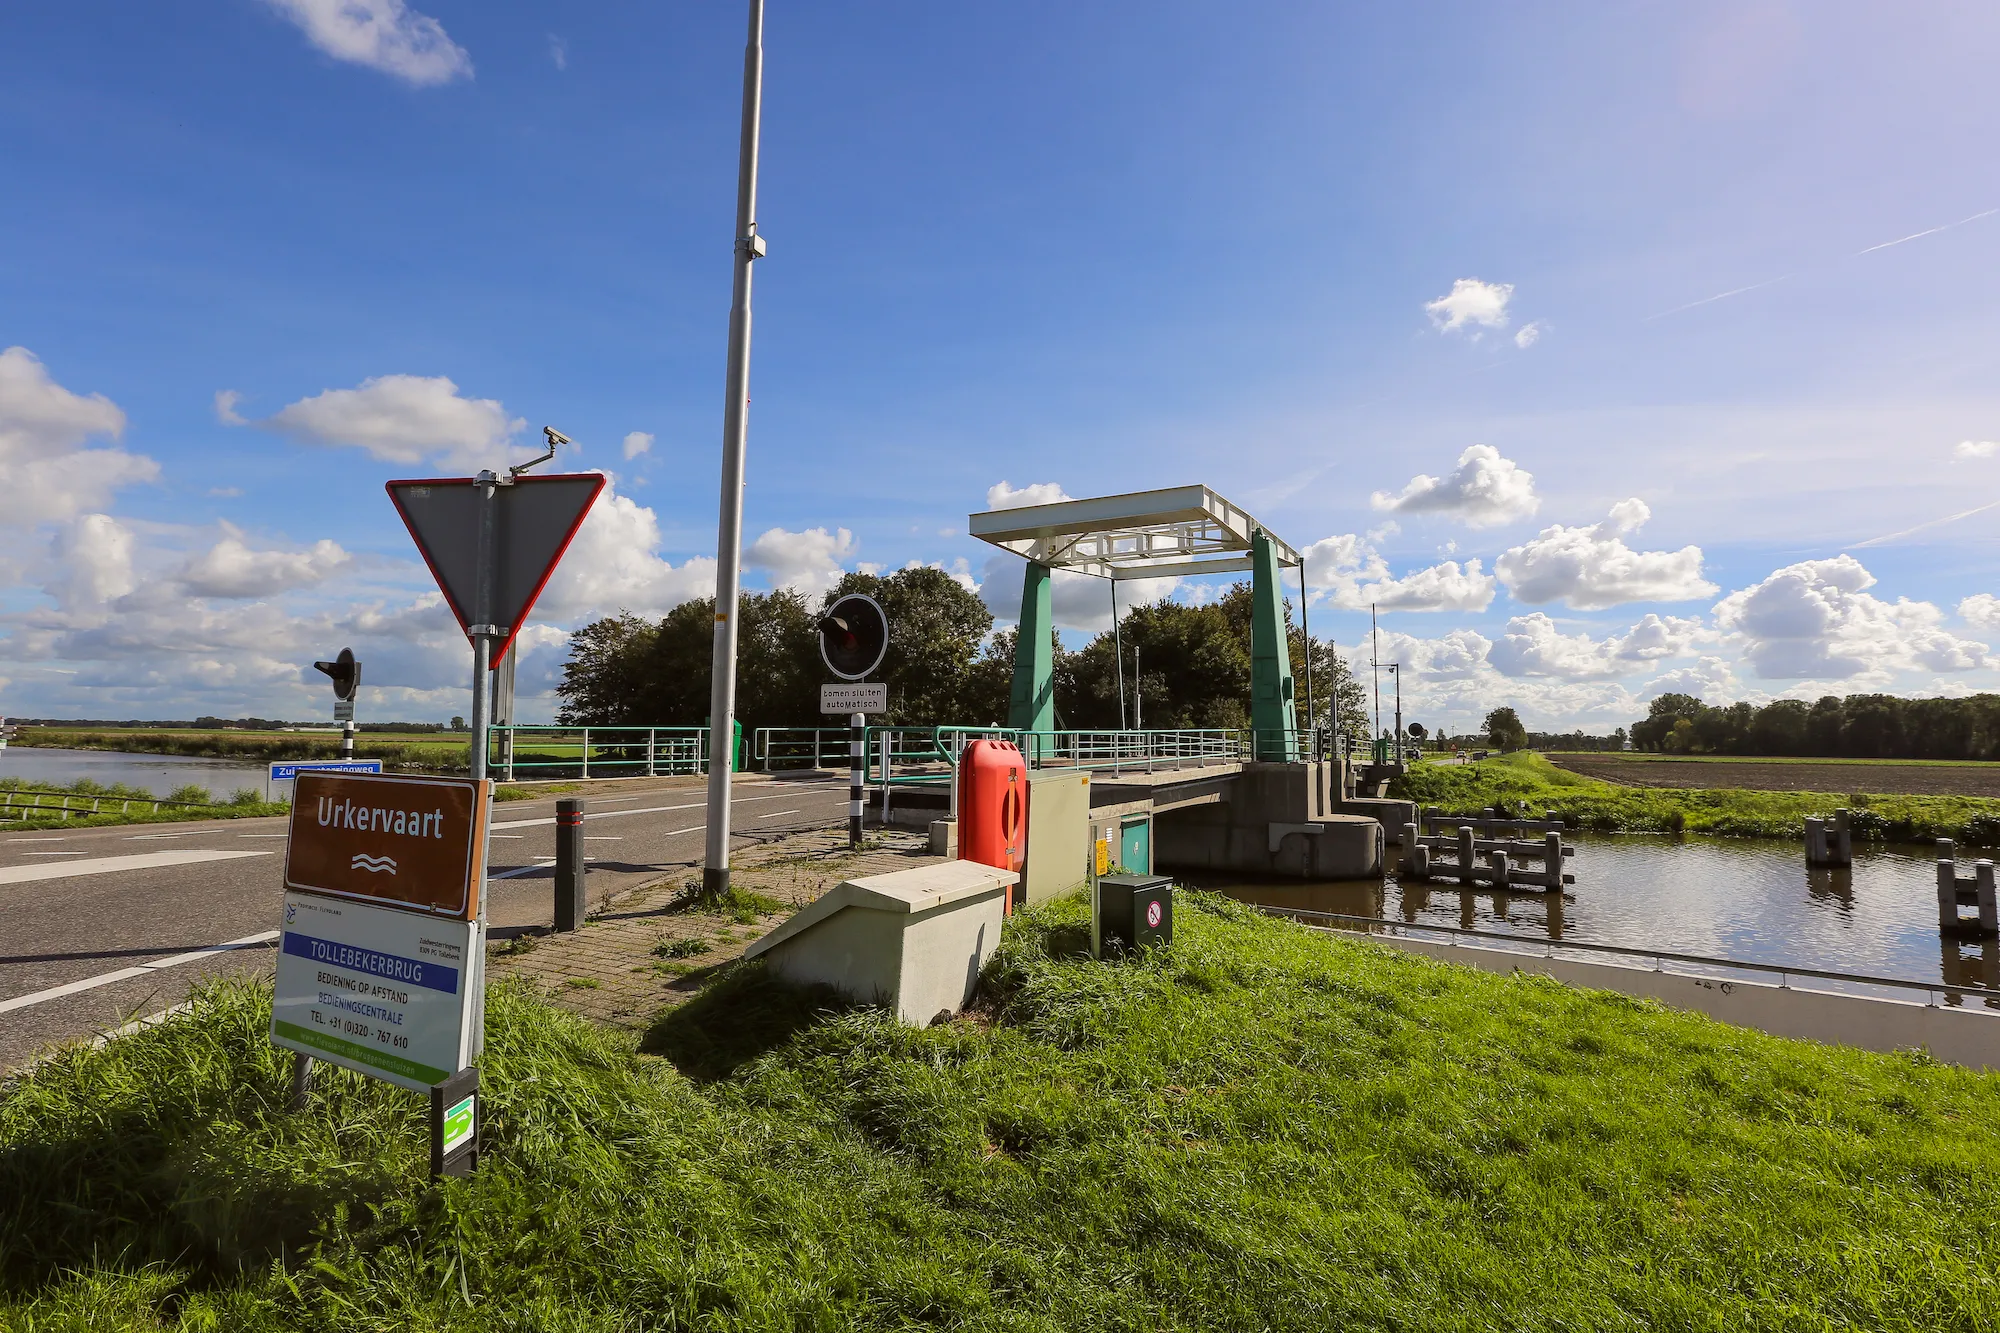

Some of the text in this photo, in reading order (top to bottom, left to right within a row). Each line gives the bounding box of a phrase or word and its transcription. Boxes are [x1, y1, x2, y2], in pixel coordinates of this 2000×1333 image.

[852, 689, 882, 697] sluiten
[318, 796, 444, 839] Urkervaart
[311, 940, 422, 983] TOLLEBEKERBRUG
[317, 971, 408, 1005] BEDIENING OP AFSTAND
[318, 991, 403, 1026] BEDIENINGSCENTRALE
[311, 1010, 326, 1025] TEL.
[329, 1017, 341, 1030] +31
[344, 1020, 369, 1037] (0)320
[377, 1029, 391, 1044] 767
[393, 1034, 408, 1050] 610
